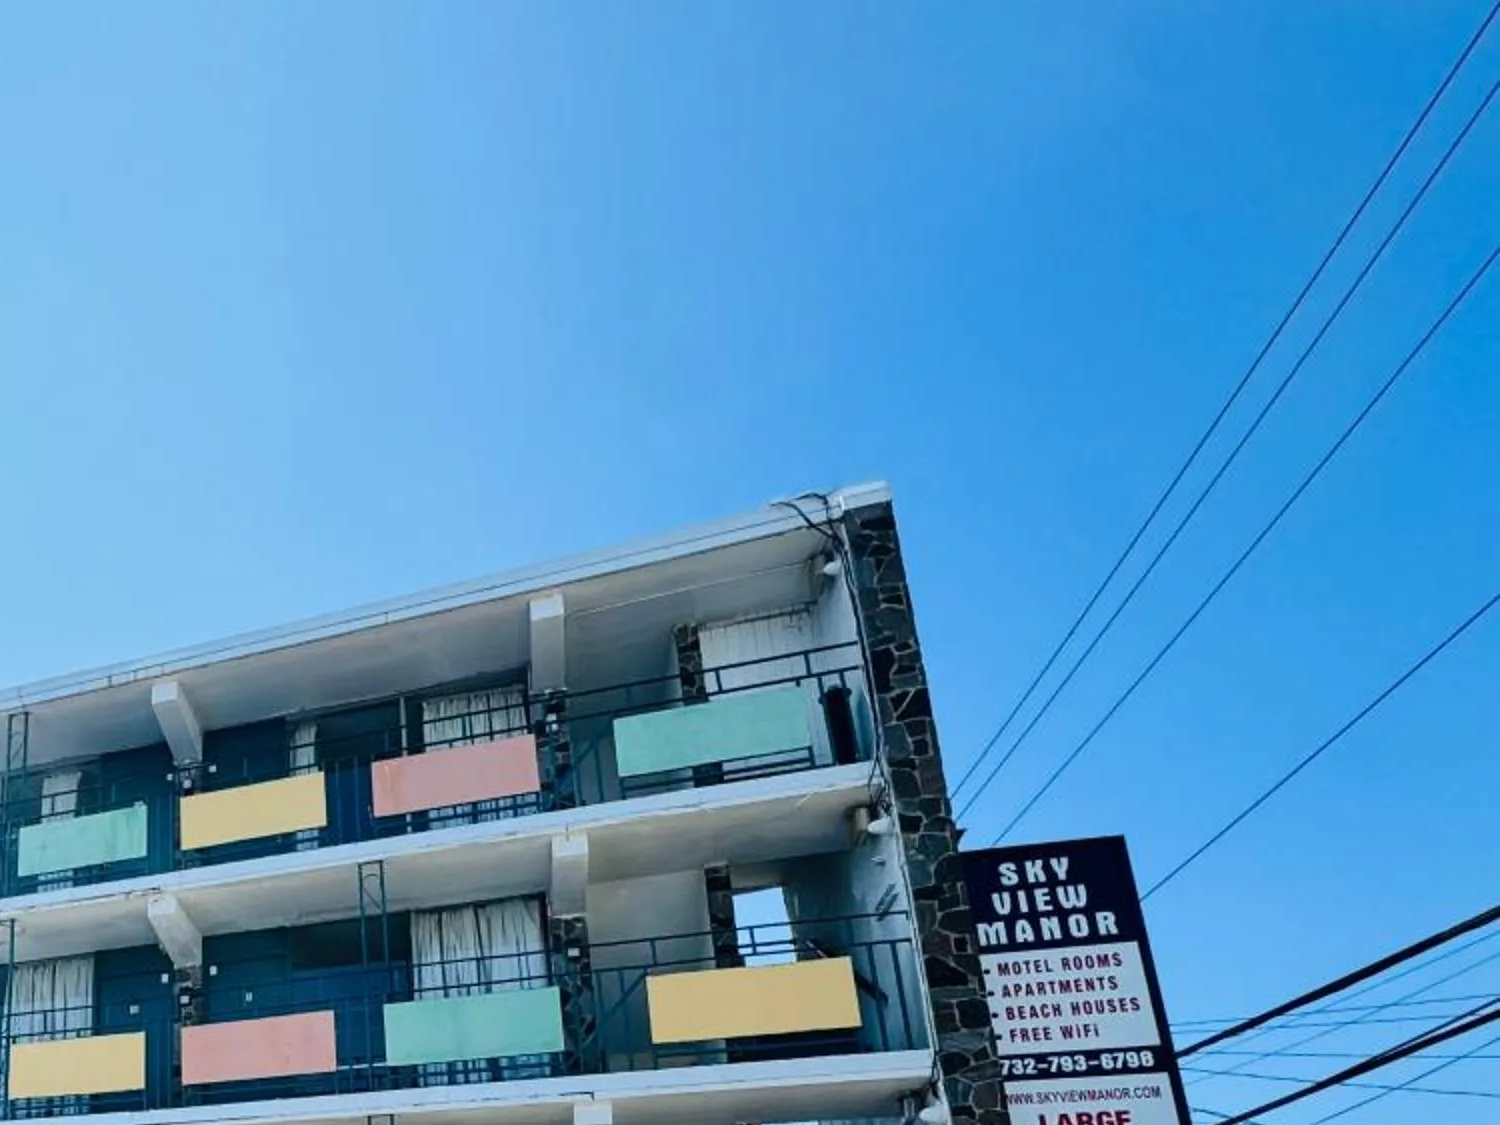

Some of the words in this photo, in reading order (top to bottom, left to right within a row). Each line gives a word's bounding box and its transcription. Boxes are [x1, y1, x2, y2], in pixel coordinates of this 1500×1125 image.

[998, 856, 1069, 886] SKY
[991, 884, 1088, 915] VIEW
[976, 911, 1119, 947] MANOR
[996, 959, 1053, 977] MOTEL
[1061, 952, 1123, 971] ROOMS
[1001, 975, 1119, 998] APARTMENTS
[1005, 1002, 1062, 1021] BEACH
[1070, 997, 1141, 1016] HOUSES
[1009, 1026, 1053, 1043] FREE
